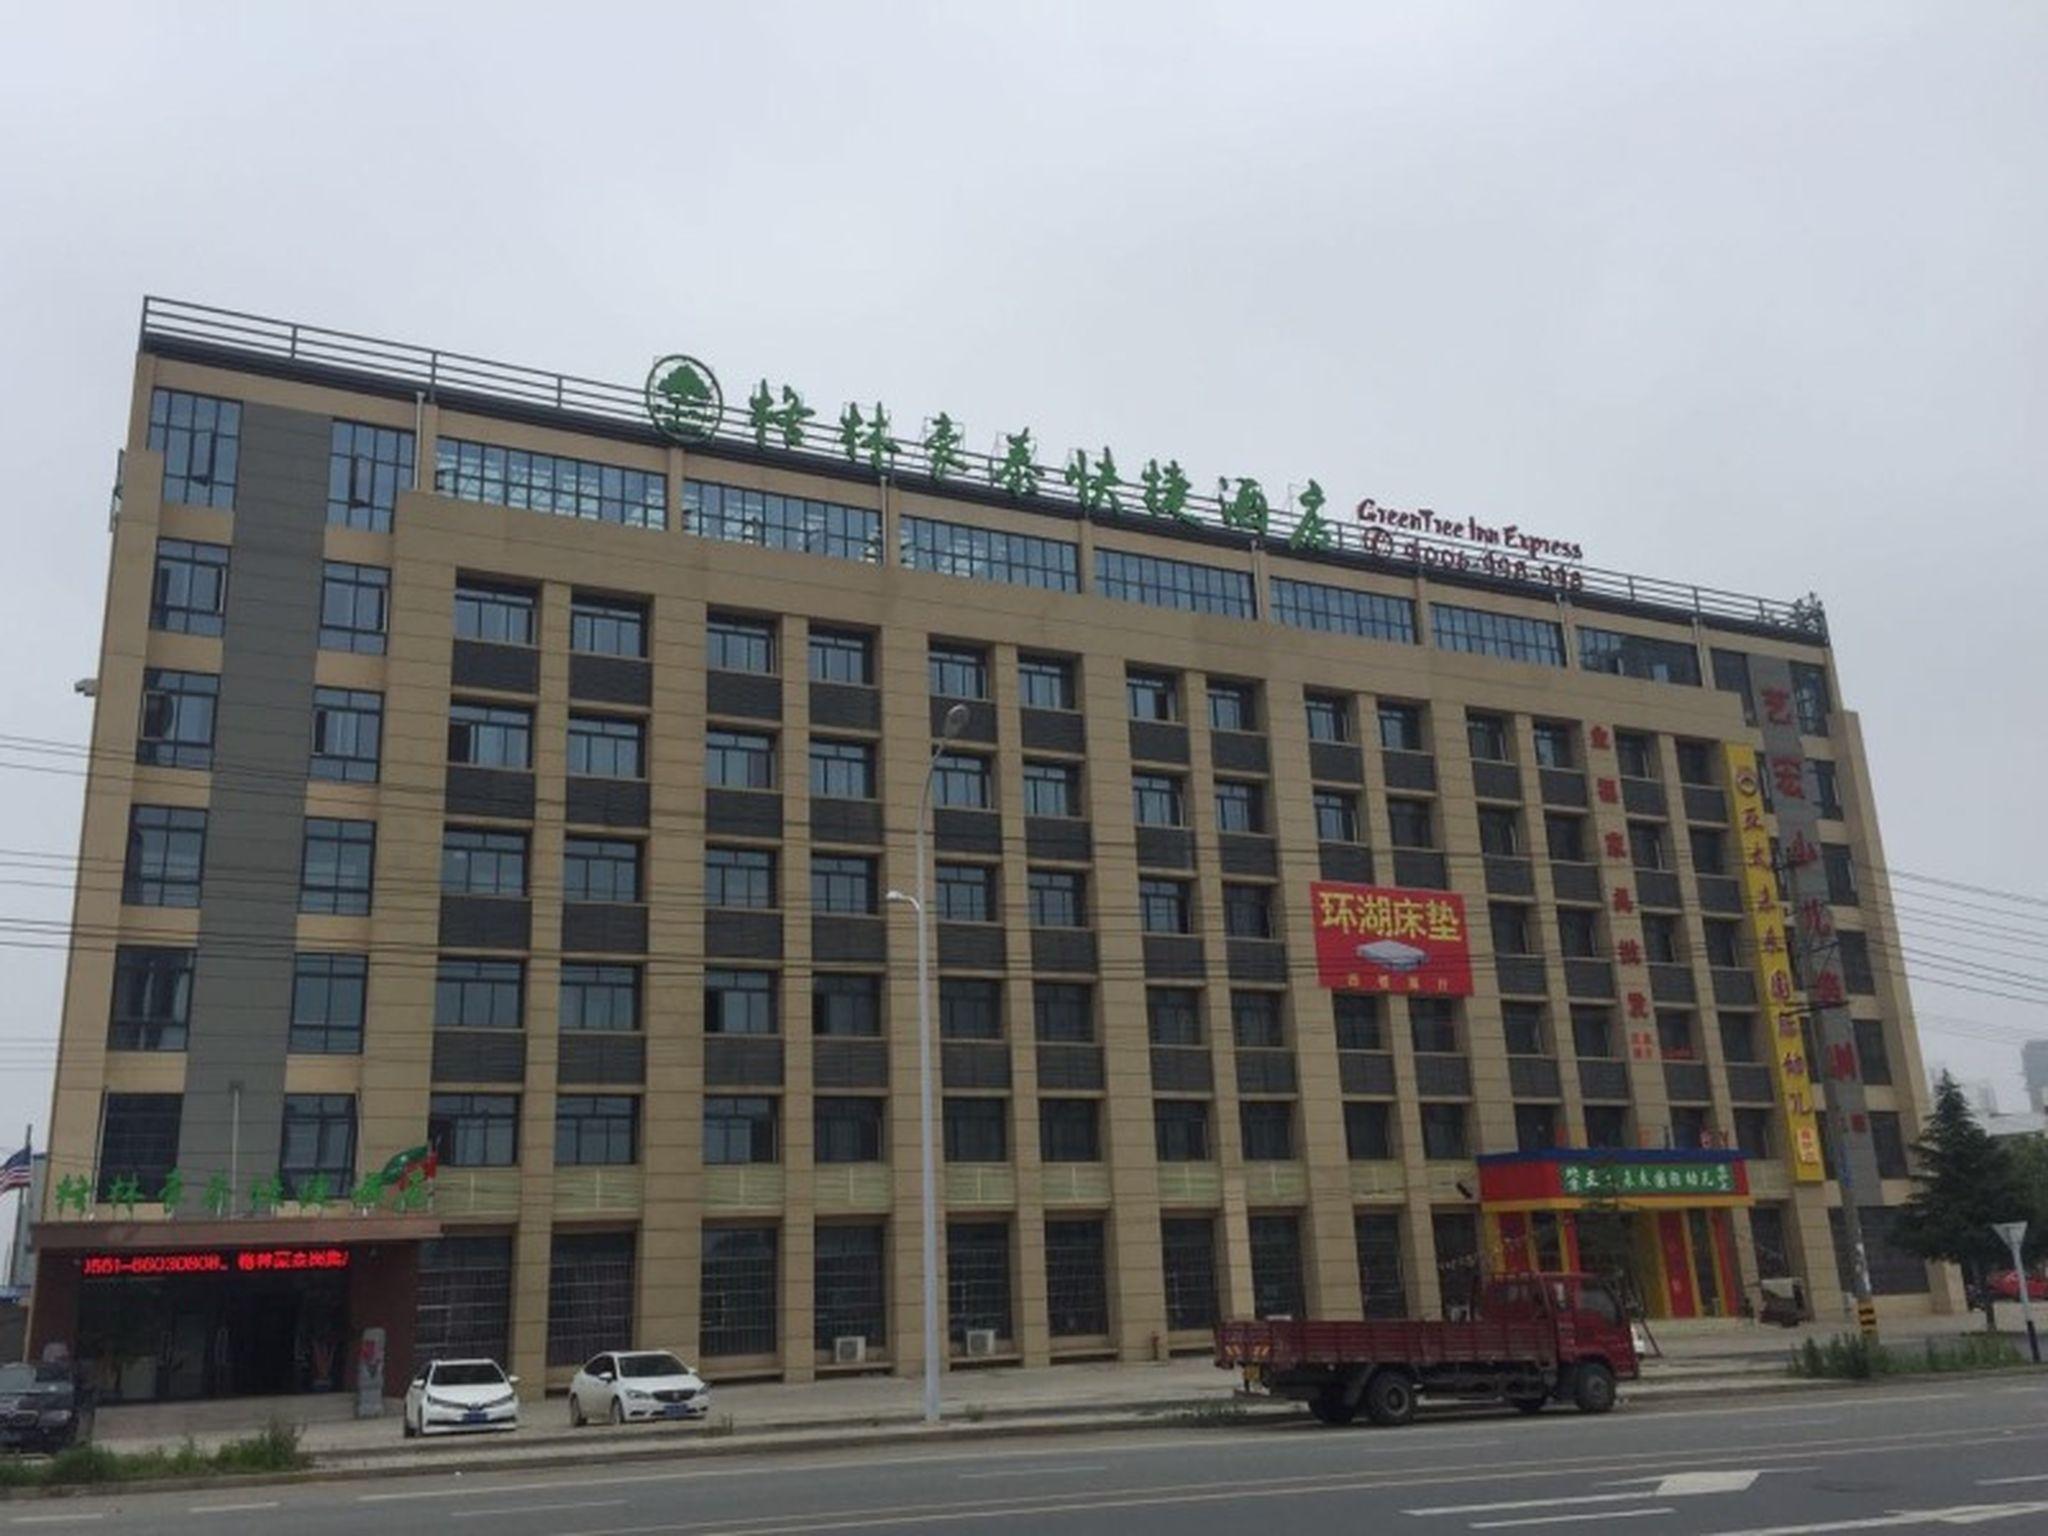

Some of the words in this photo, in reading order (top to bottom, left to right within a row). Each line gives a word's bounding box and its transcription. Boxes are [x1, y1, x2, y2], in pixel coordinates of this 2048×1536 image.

[1357, 498, 1464, 540] GreenTree
[1469, 516, 1499, 545] Inn
[1504, 525, 1583, 560] Express
[1318, 891, 1462, 942] 环湖床垫
